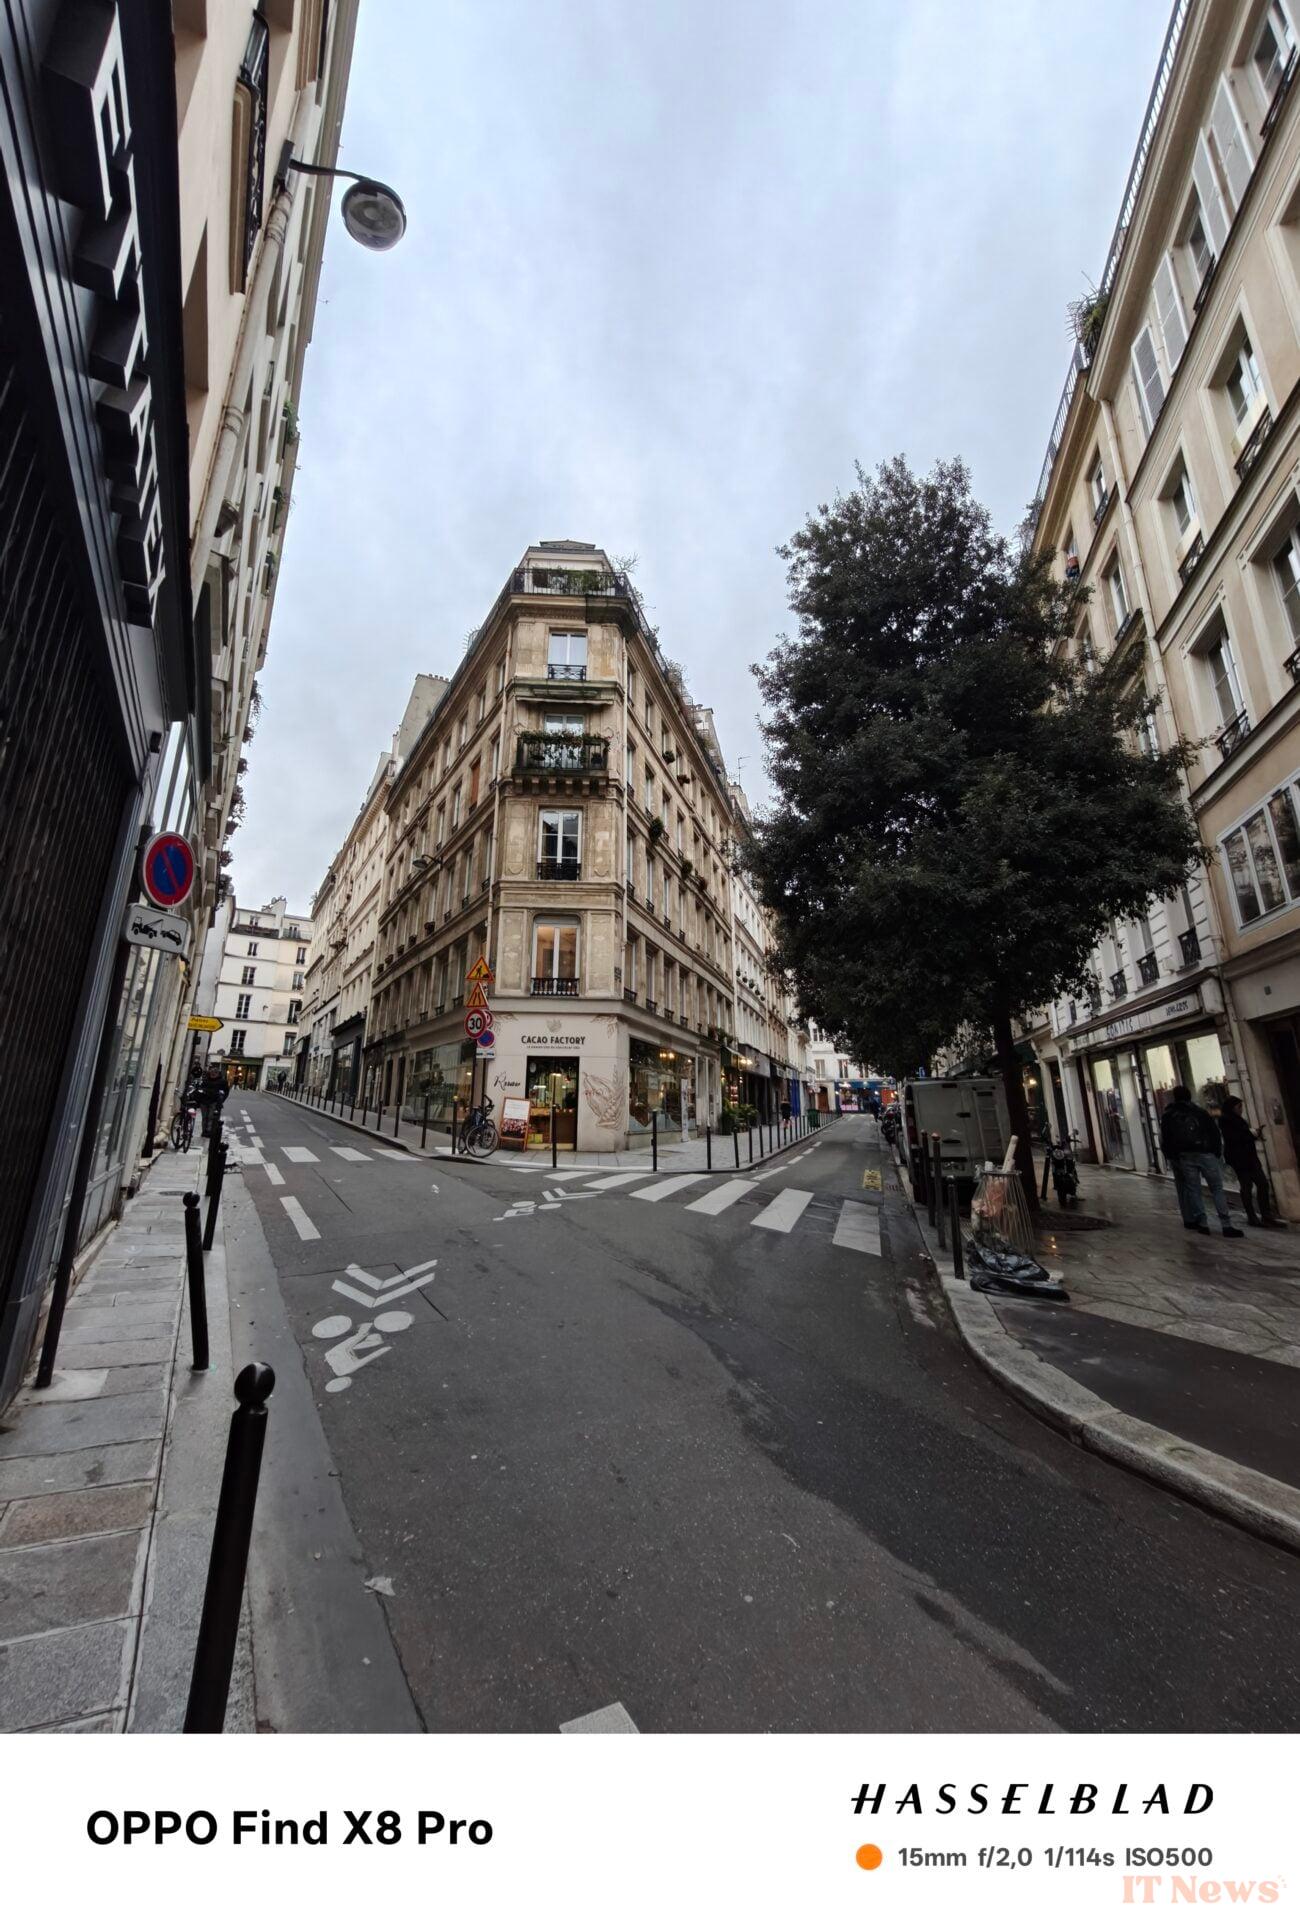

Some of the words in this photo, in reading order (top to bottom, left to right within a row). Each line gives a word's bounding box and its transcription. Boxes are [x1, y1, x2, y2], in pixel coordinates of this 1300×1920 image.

[469, 1017, 483, 1030] 30
[521, 1035, 548, 1044] CACAO
[550, 1036, 586, 1045] FACTORY
